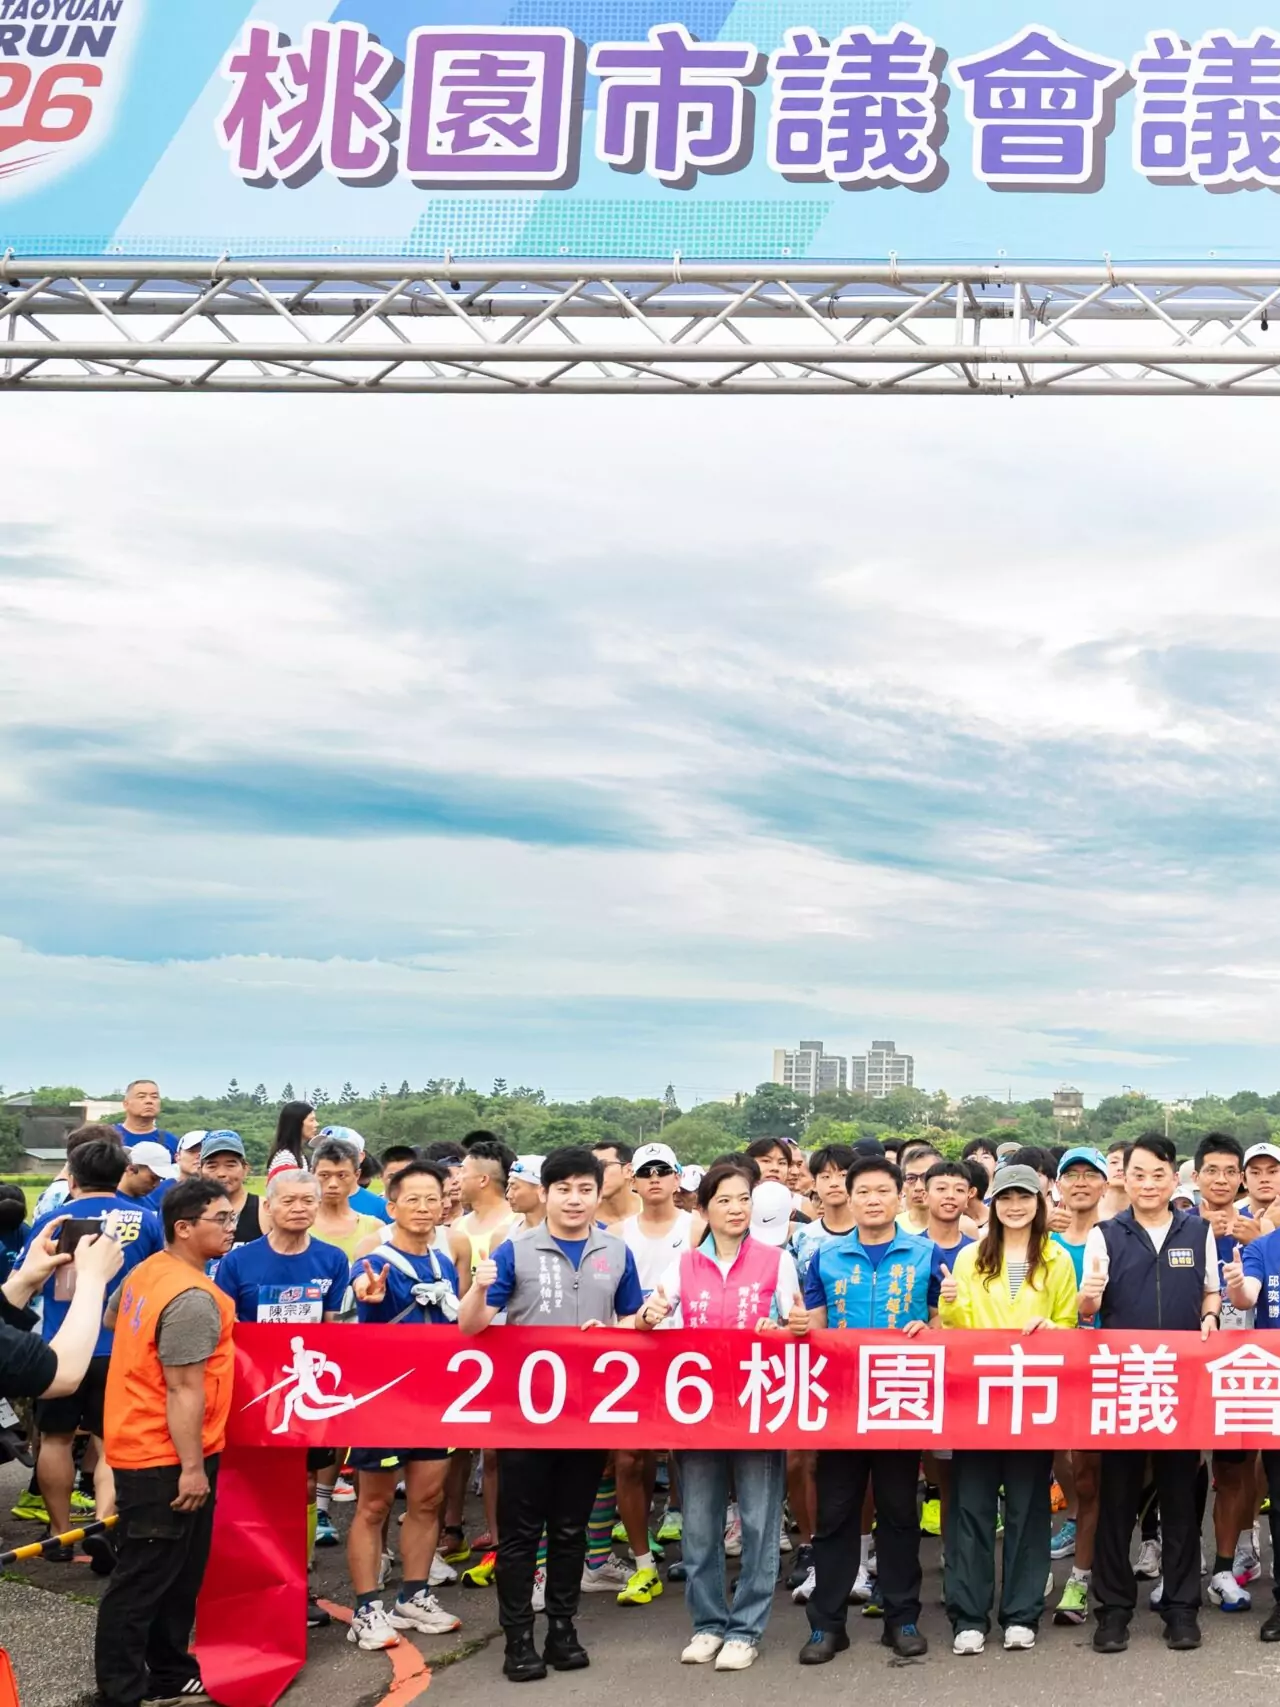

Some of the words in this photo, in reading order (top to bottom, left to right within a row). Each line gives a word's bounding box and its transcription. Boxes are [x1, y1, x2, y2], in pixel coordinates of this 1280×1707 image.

[0, 24, 117, 58] RUN
[268, 1303, 312, 1318] 陳宗淳
[1267, 1275, 1280, 1318] 邱奕勝
